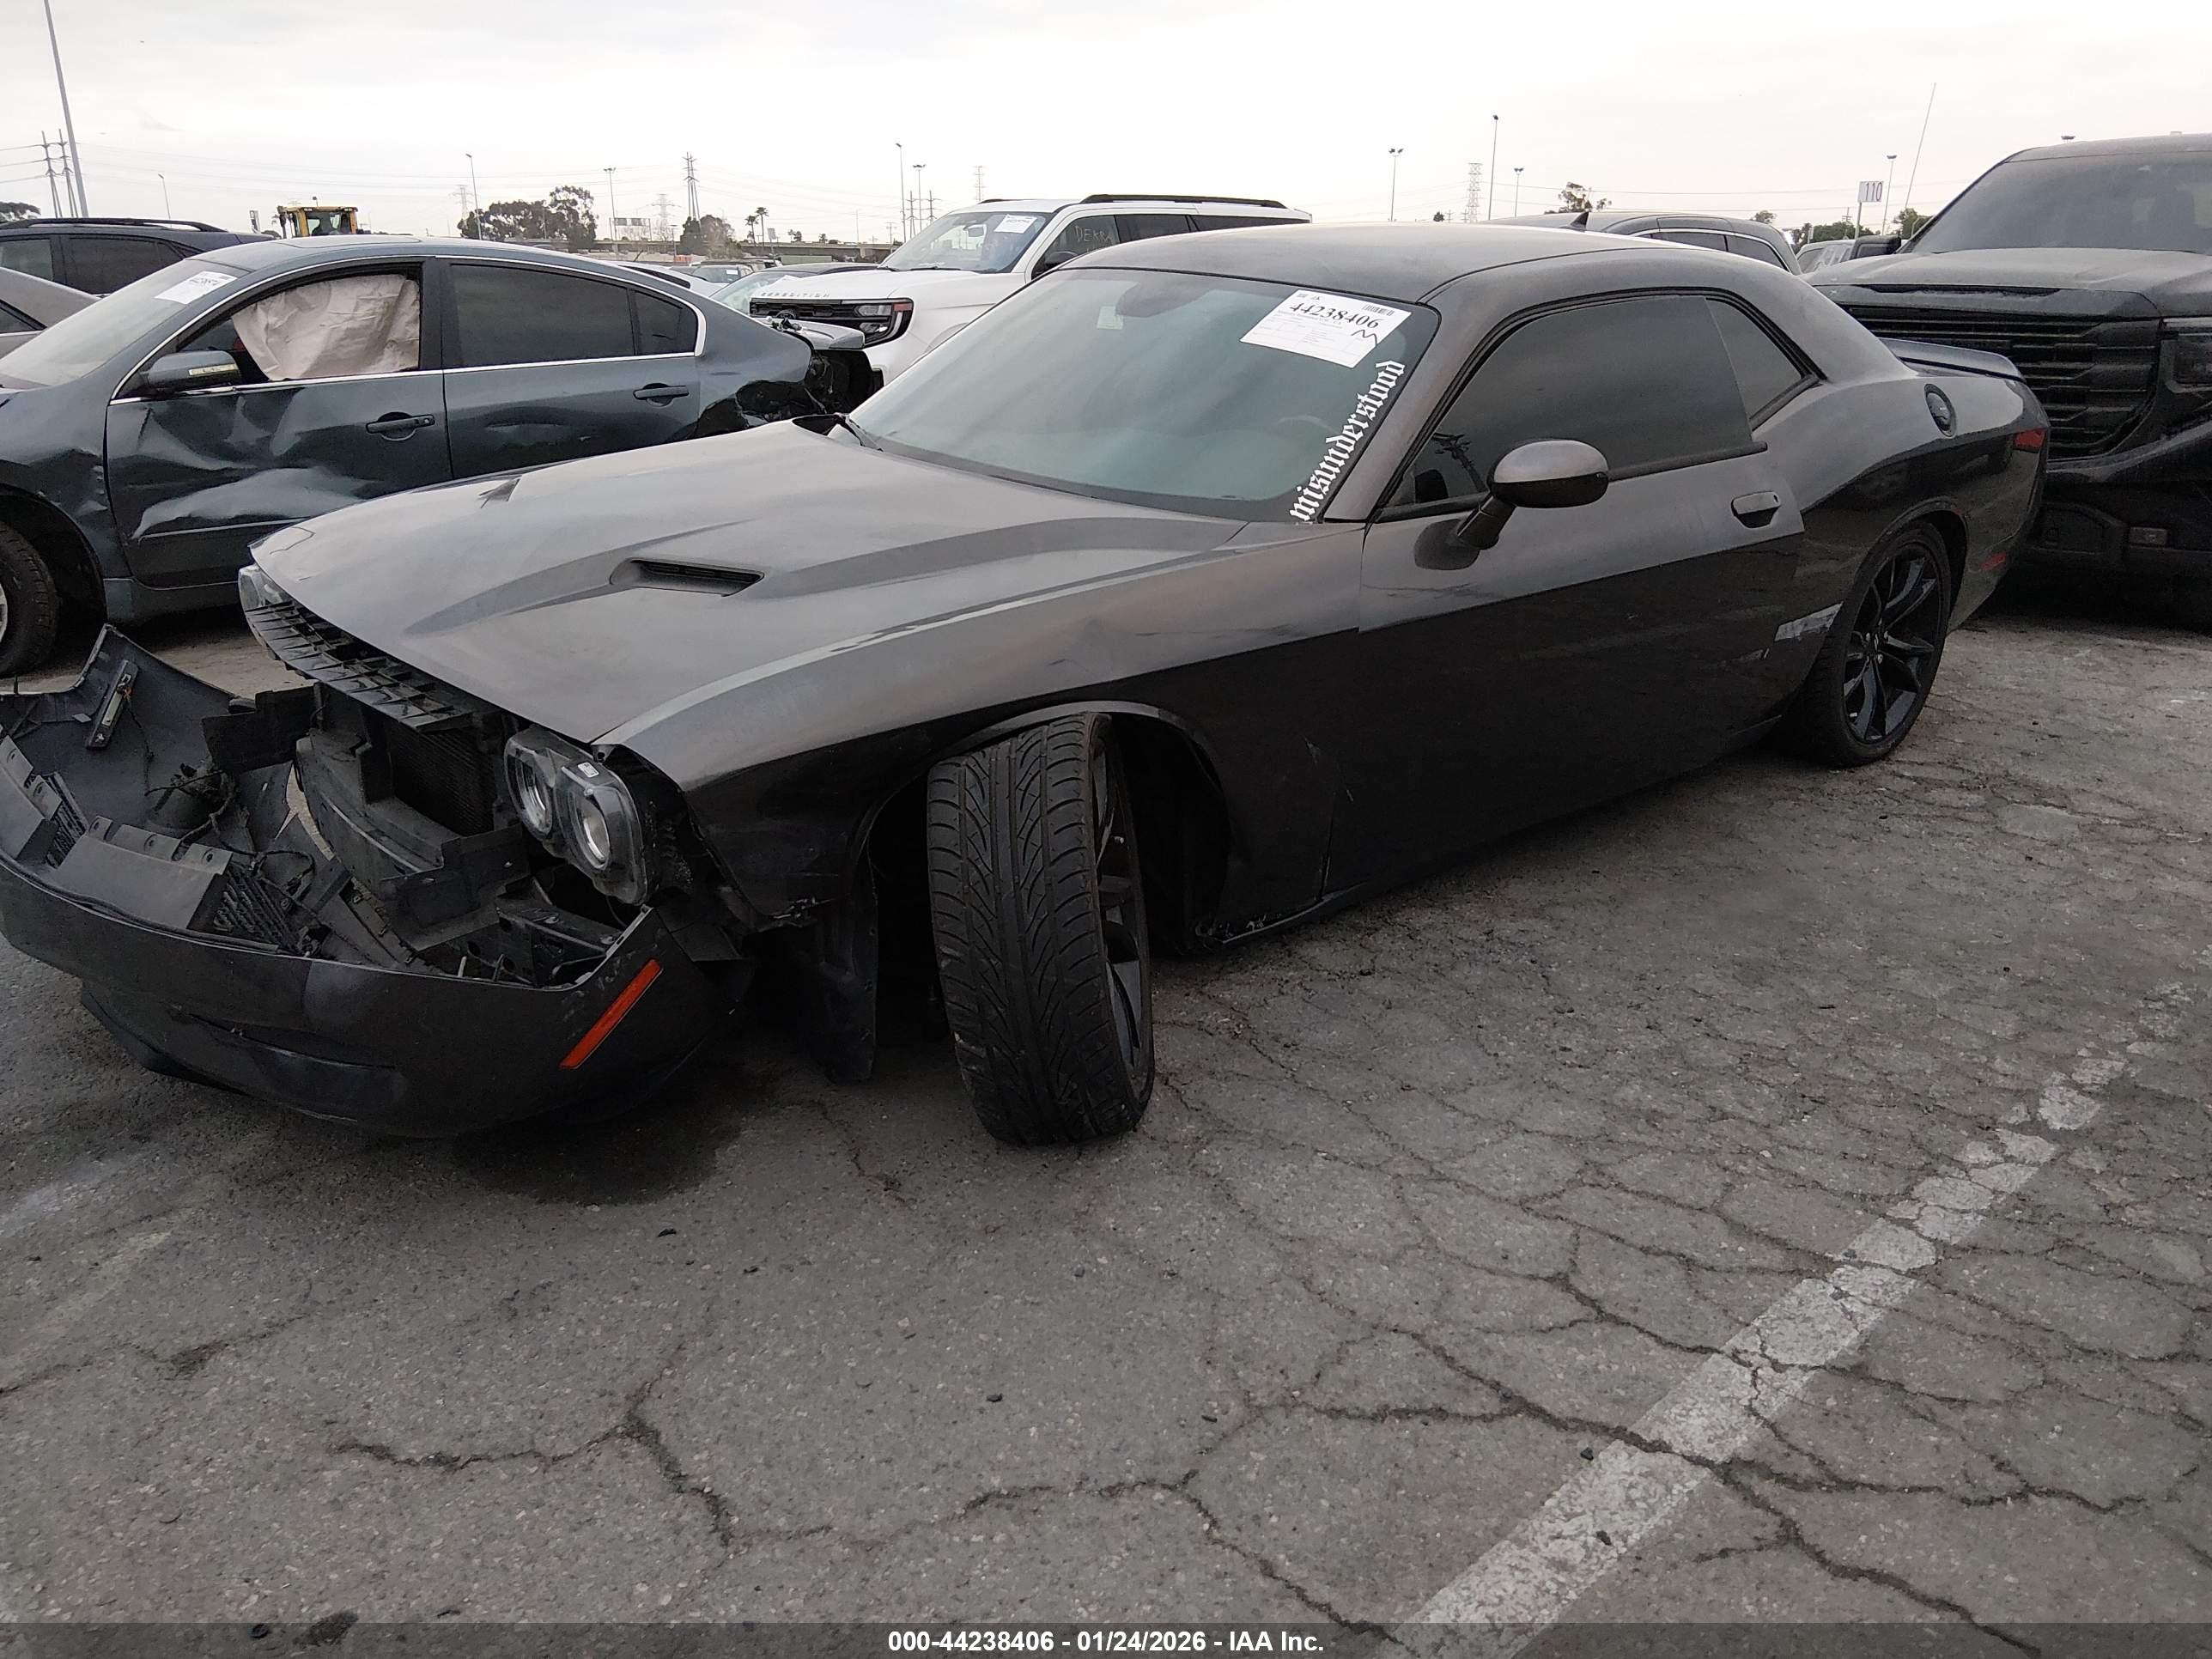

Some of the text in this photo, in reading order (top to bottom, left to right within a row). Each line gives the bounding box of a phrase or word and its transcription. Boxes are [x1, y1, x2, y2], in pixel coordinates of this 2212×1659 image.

[1865, 182, 1883, 201] 110
[1290, 302, 1382, 329] 44238406
[1290, 360, 1406, 521] misunderstood
